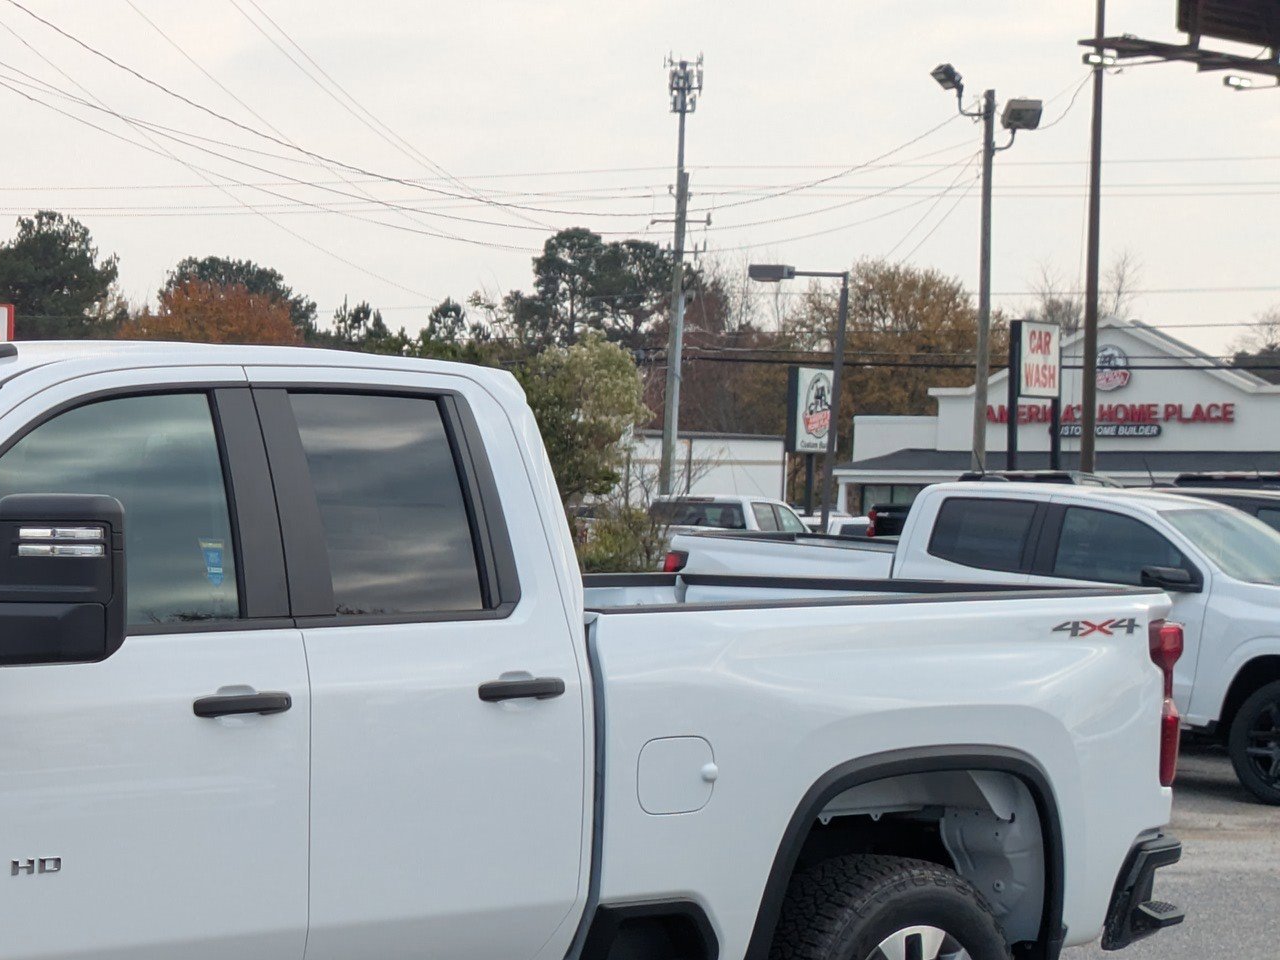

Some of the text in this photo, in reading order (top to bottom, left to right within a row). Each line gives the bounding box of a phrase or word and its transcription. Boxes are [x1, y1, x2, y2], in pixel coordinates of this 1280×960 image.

[1029, 330, 1052, 356] CAR
[1024, 362, 1056, 389] WASH
[1097, 403, 1159, 424] HOME
[1163, 403, 1235, 424] PLACE
[1117, 425, 1158, 436] BUILDER
[10, 855, 62, 877] HD
